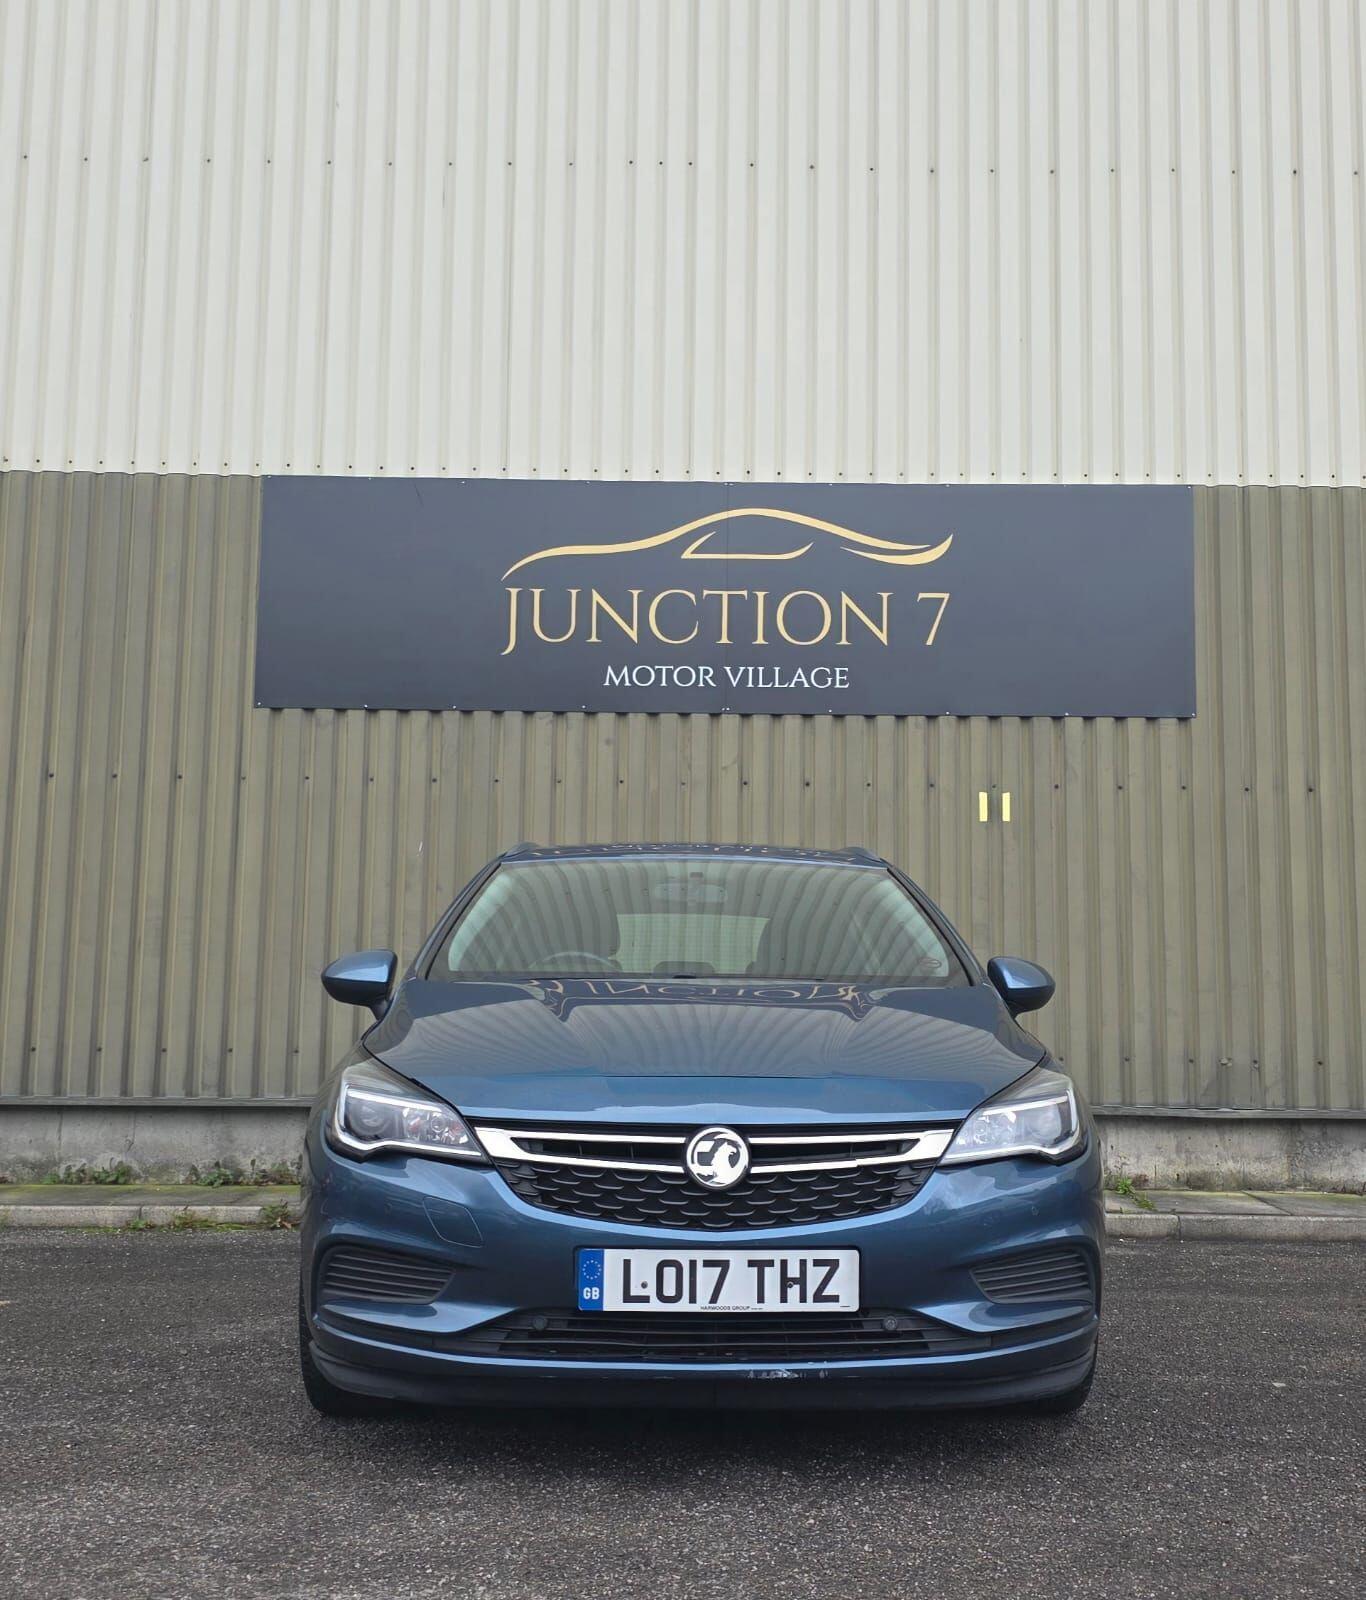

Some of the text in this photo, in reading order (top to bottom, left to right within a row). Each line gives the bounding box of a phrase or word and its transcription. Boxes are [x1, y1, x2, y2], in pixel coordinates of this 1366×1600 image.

[501, 587, 951, 656] JUNCTION 7
[603, 665, 850, 689] MOTOR VILLAGE
[582, 1287, 600, 1300] GB
[622, 1258, 840, 1305] LO17 THZ
